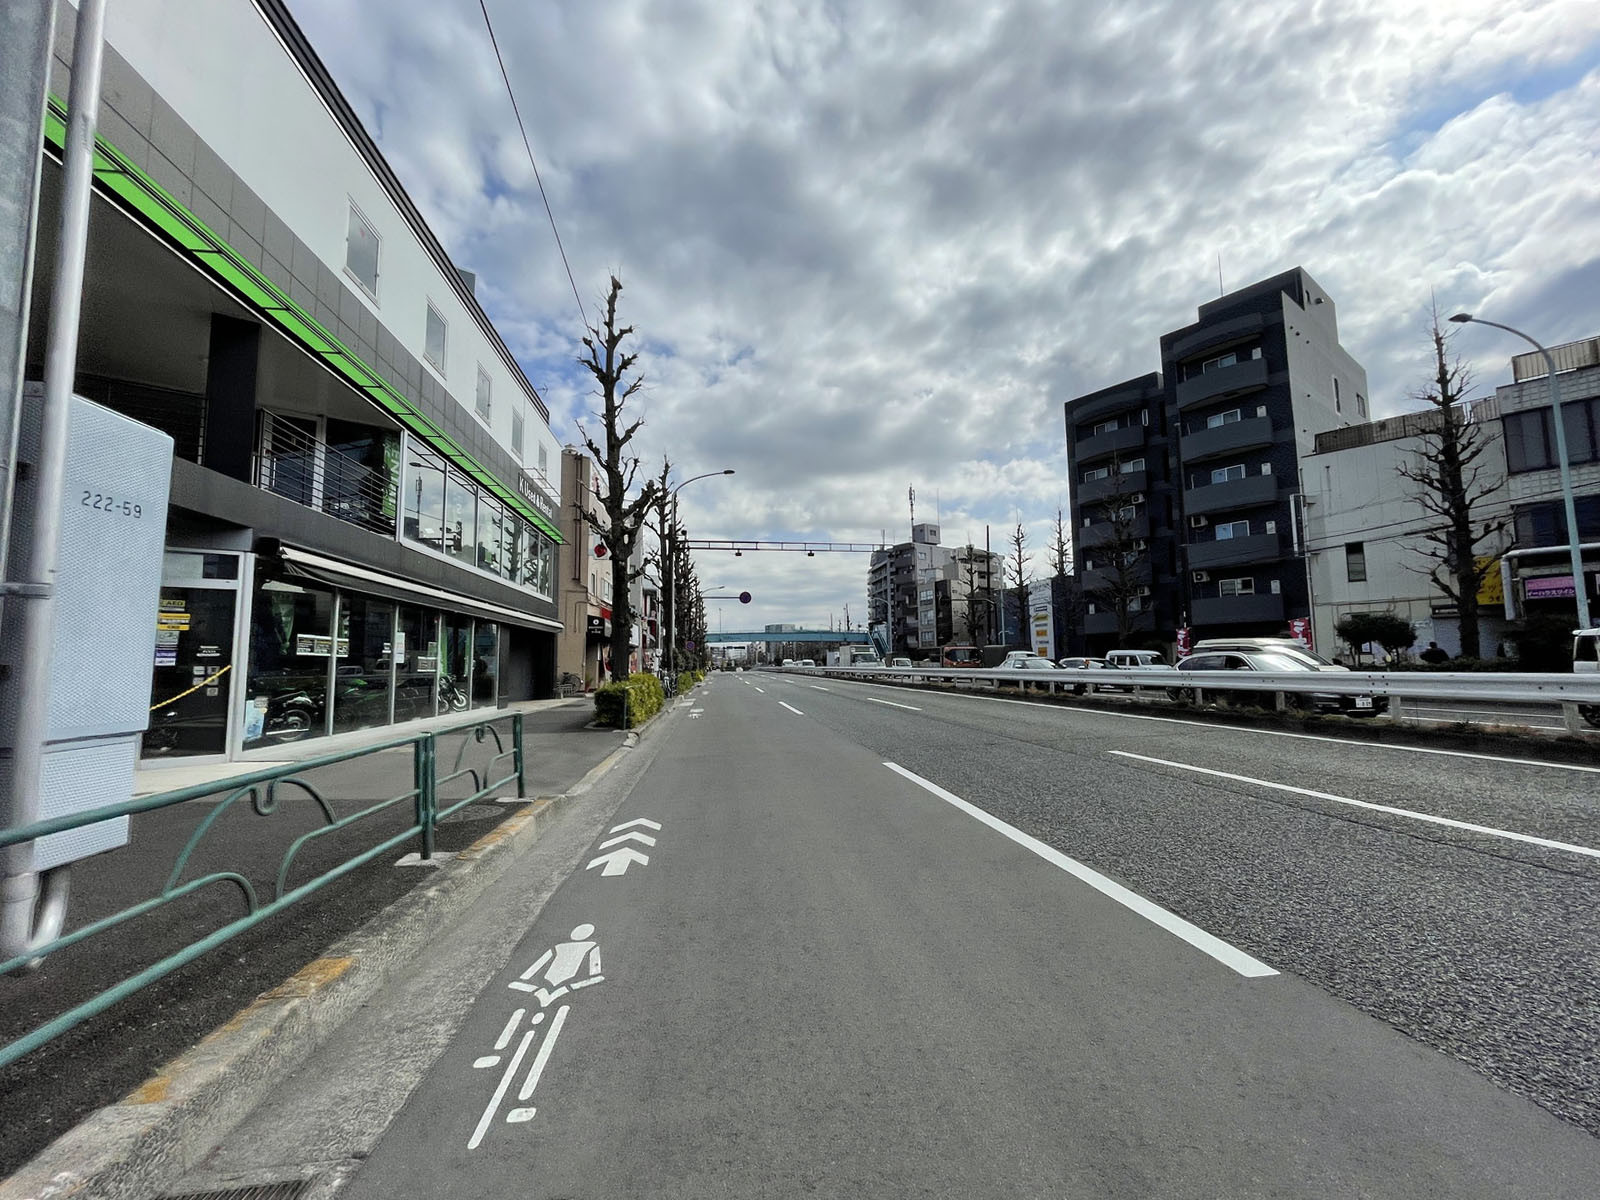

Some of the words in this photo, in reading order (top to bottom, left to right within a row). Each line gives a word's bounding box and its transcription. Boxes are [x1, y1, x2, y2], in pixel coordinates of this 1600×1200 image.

[81, 490, 142, 519] 222-59
[524, 480, 536, 505] Used
[540, 496, 553, 520] Rental
